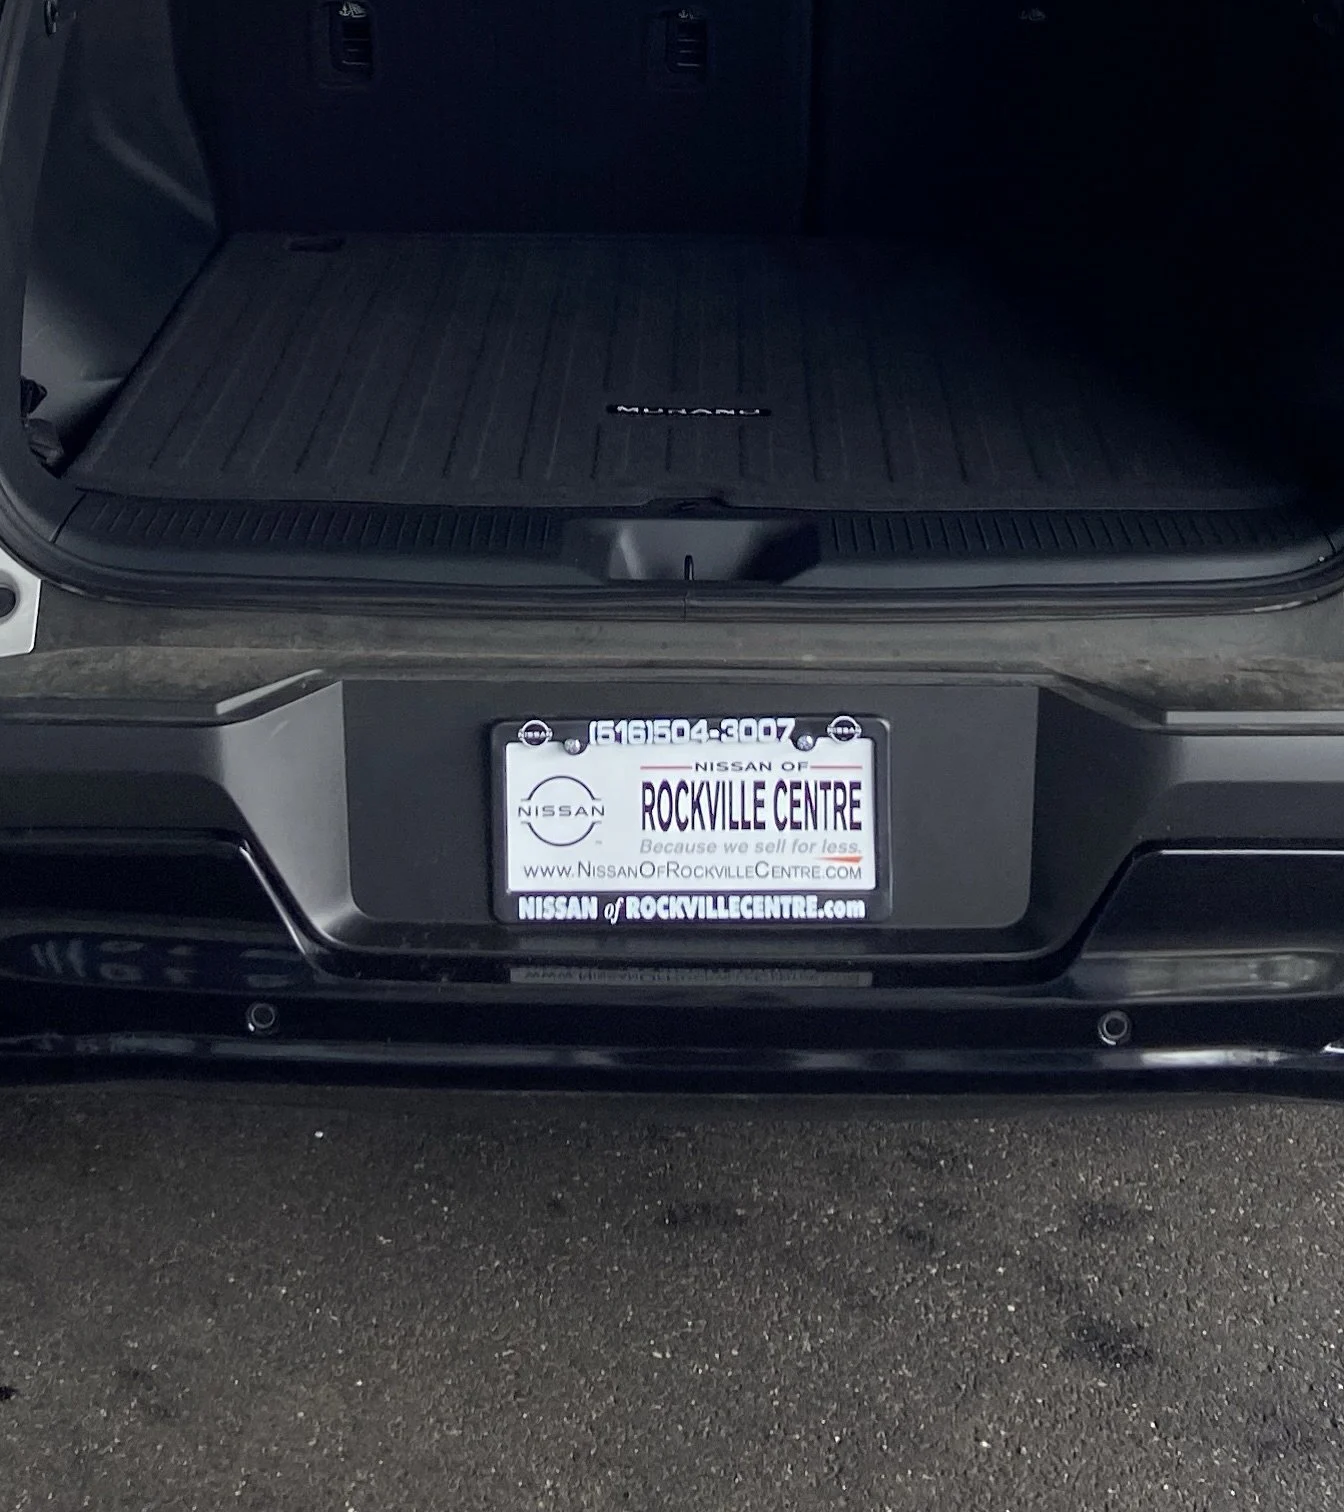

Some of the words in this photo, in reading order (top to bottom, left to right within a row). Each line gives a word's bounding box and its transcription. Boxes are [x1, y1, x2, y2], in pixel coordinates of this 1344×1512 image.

[695, 761, 772, 772] NISSAN
[781, 761, 809, 772] OF
[518, 805, 605, 818] NISSAN
[641, 780, 766, 832] ROCKVILLE
[773, 779, 862, 832] CENTRE
[640, 838, 717, 854] Because
[724, 843, 749, 854] we
[755, 838, 786, 854] sell
[792, 838, 817, 854] for
[822, 838, 862, 854] less.
[519, 895, 598, 920] NISSAN
[604, 896, 624, 924] of
[625, 894, 865, 920] ROCKVILLECENTRE.com
